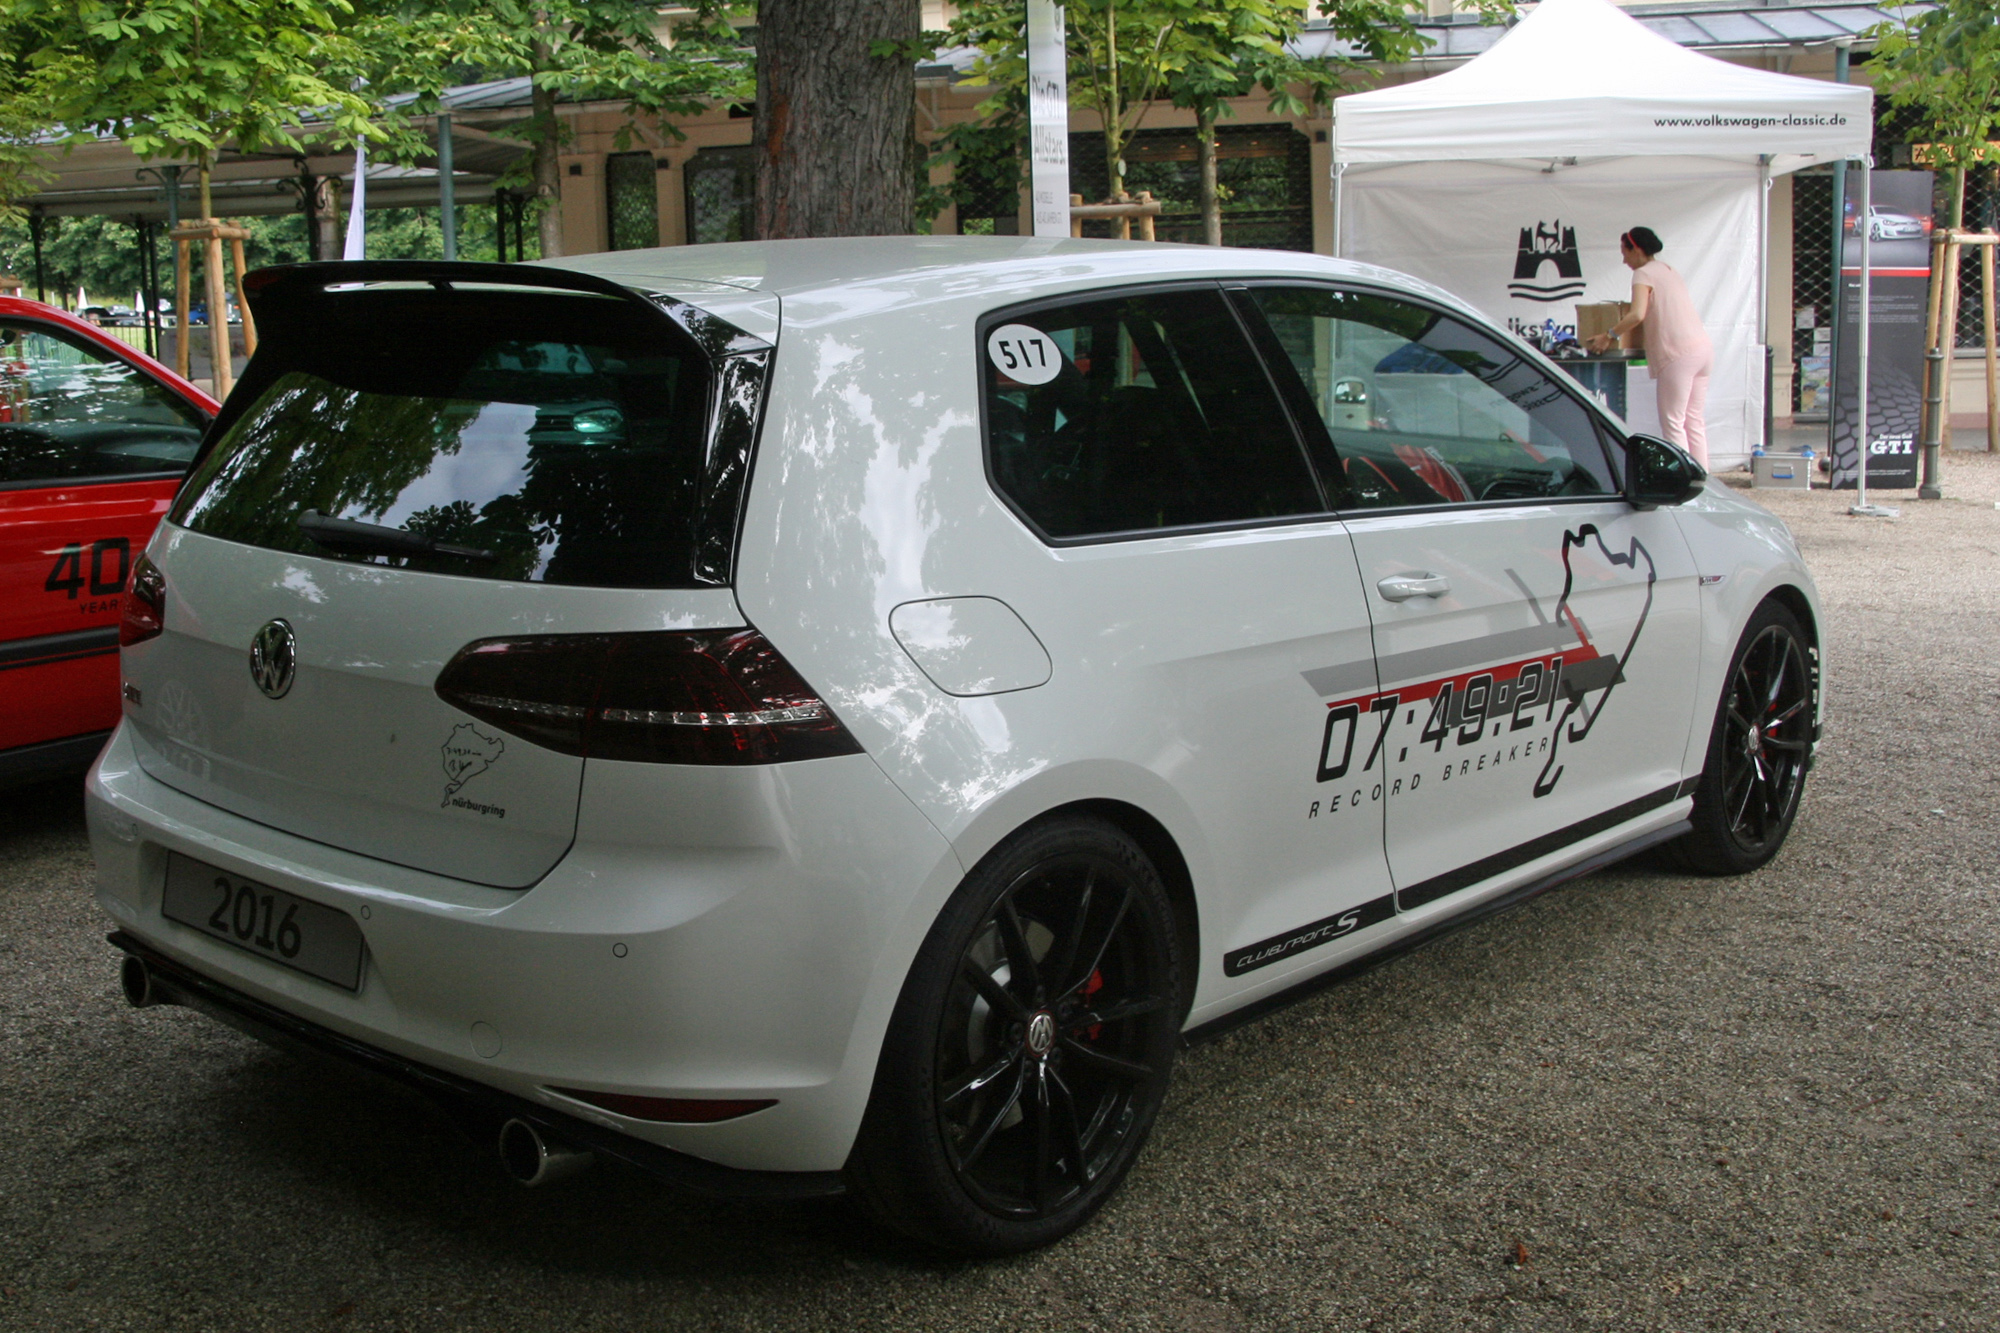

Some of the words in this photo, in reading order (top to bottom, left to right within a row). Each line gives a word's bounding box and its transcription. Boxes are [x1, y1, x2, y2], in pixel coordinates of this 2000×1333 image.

[1654, 113, 1847, 129] www.volkswagen-classic.de
[998, 338, 1047, 370] 517
[1870, 440, 1913, 455] GTI
[44, 537, 131, 600] 40
[80, 599, 119, 615] YEAR
[1308, 773, 1421, 819] RECORD
[1442, 736, 1548, 782] BREAKER
[452, 797, 506, 819] nürburgring
[208, 877, 302, 959] 2016
